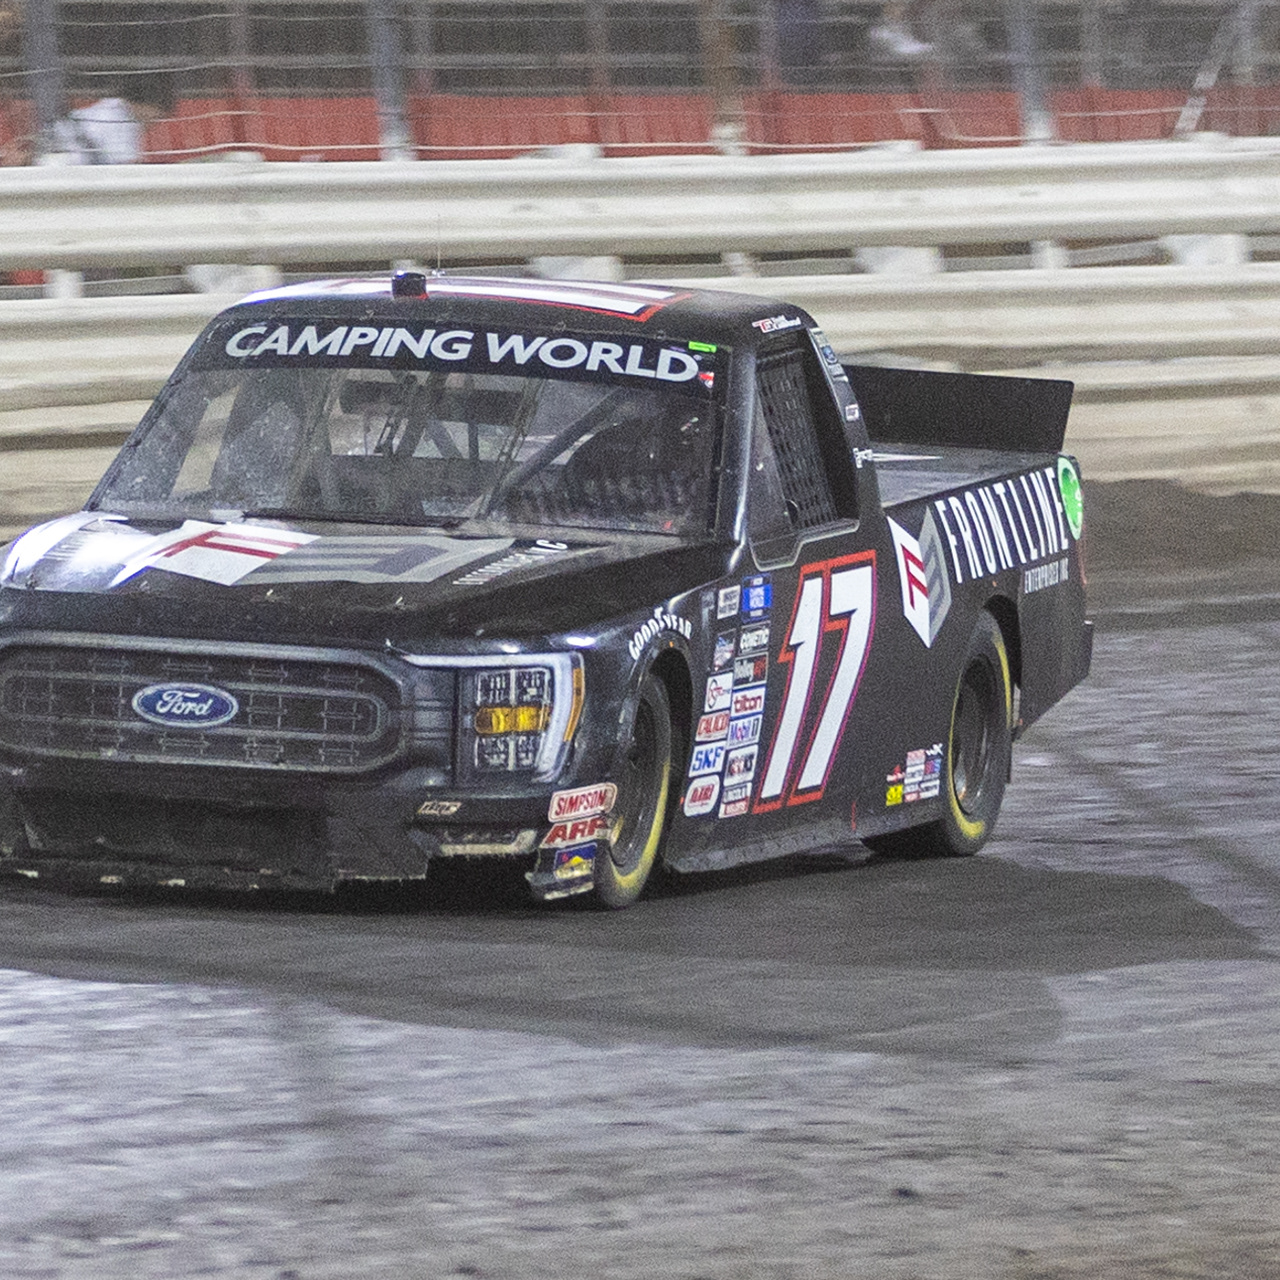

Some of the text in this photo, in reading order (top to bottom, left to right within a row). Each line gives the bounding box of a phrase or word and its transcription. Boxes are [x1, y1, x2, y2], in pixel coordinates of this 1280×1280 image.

[225, 326, 699, 382] CAMPING WORLD
[934, 467, 1069, 584] FRONTLINE
[629, 606, 692, 660] GOODYEAR
[759, 561, 875, 803] 17
[156, 689, 213, 718] Ford
[734, 694, 762, 714] tilton
[692, 746, 725, 771] SKF
[555, 789, 607, 816] SIMPSON
